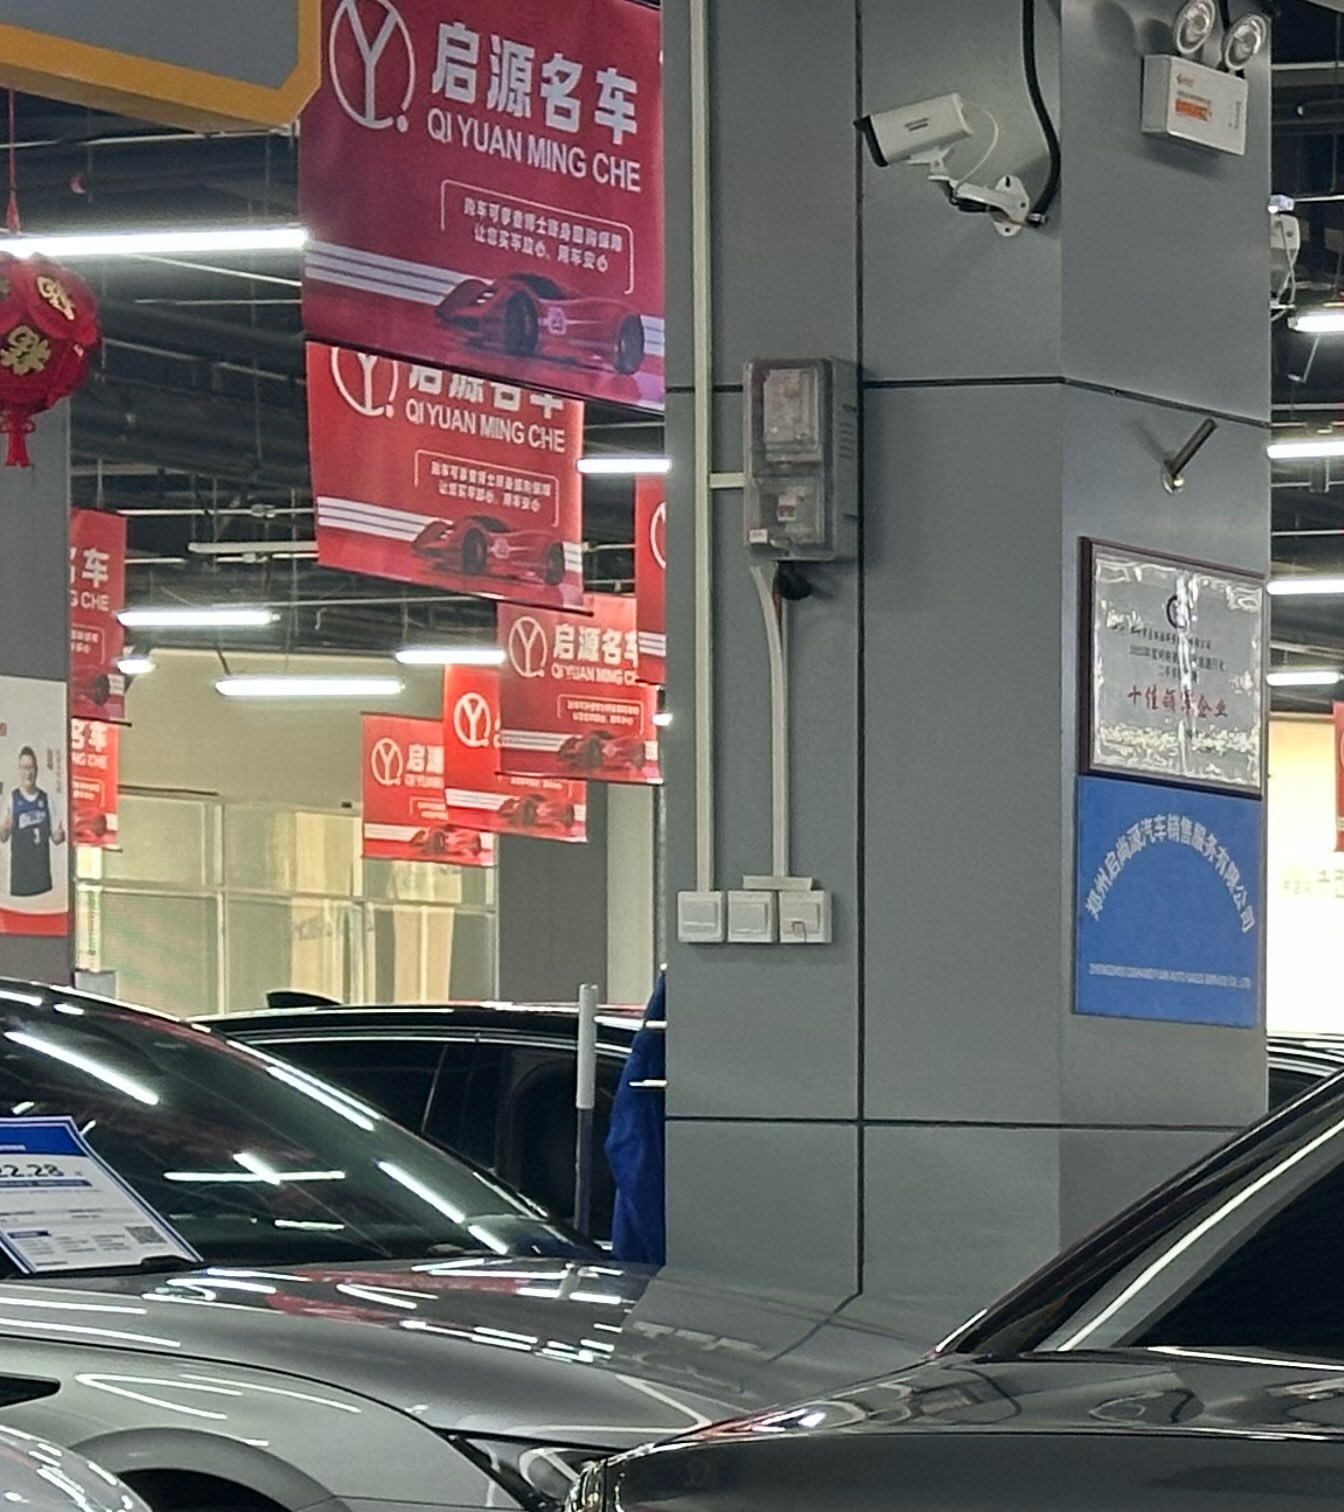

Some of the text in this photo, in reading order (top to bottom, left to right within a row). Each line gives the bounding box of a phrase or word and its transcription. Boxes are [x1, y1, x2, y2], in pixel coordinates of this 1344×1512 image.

[432, 22, 638, 146] 启源名车
[427, 108, 642, 192] QI YUAN MING CHE
[406, 399, 565, 453] QI YUAN MING CHE
